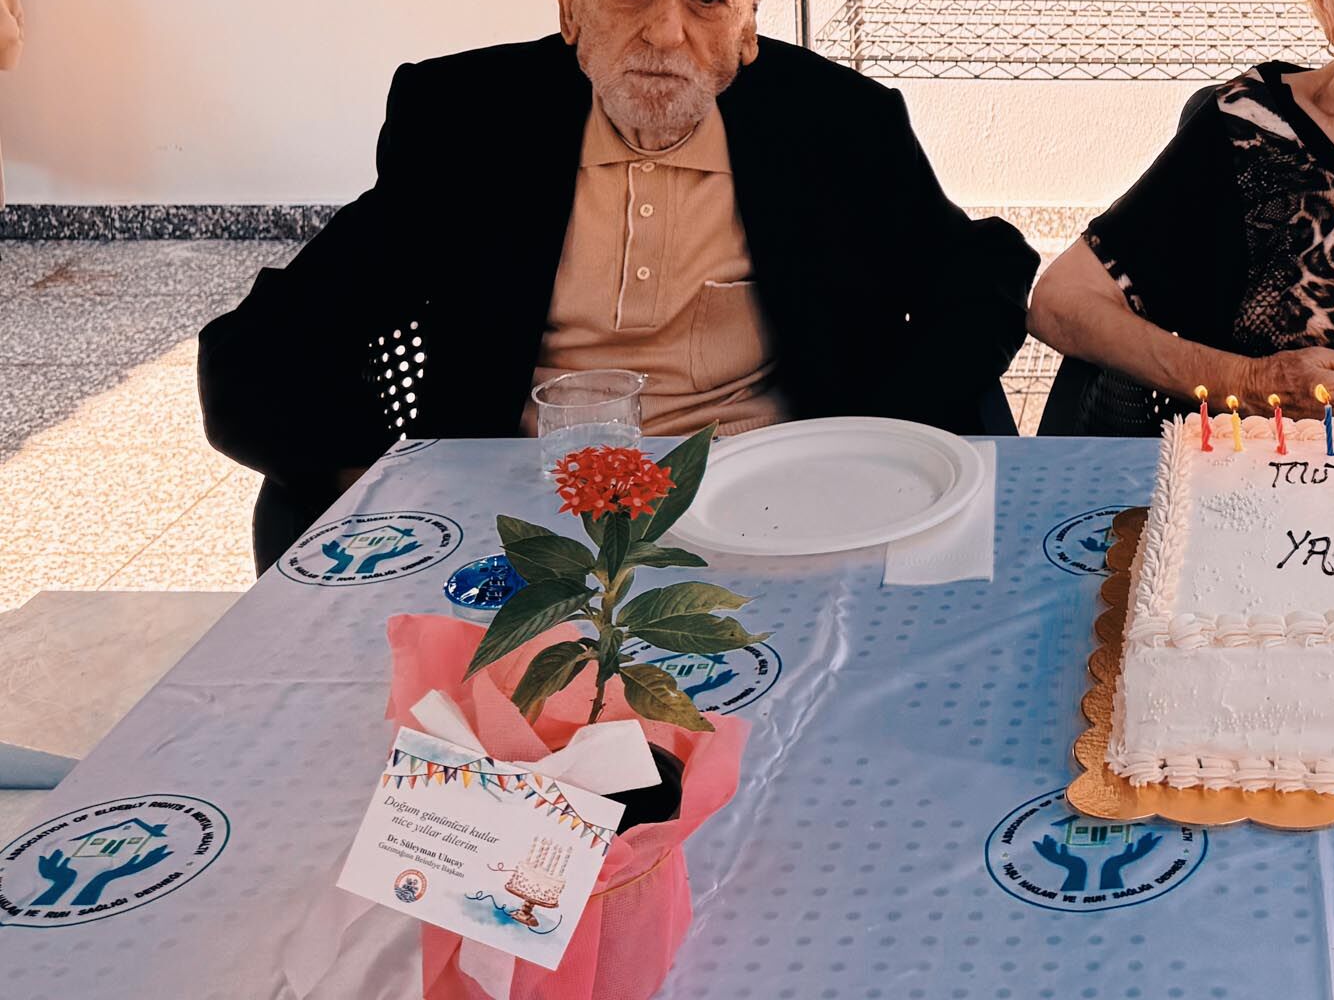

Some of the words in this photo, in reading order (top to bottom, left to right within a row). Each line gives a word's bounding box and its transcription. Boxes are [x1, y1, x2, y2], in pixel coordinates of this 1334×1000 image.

[384, 795, 421, 816] Doğum
[420, 810, 469, 834] gününüzü
[469, 826, 500, 844] kutlar
[391, 815, 413, 829] nice
[411, 823, 442, 839] yıllar
[442, 833, 478, 853] dilerim.
[387, 834, 398, 845] Dr.
[400, 839, 437, 858] Süleyman
[438, 852, 465, 869] Uluçay
